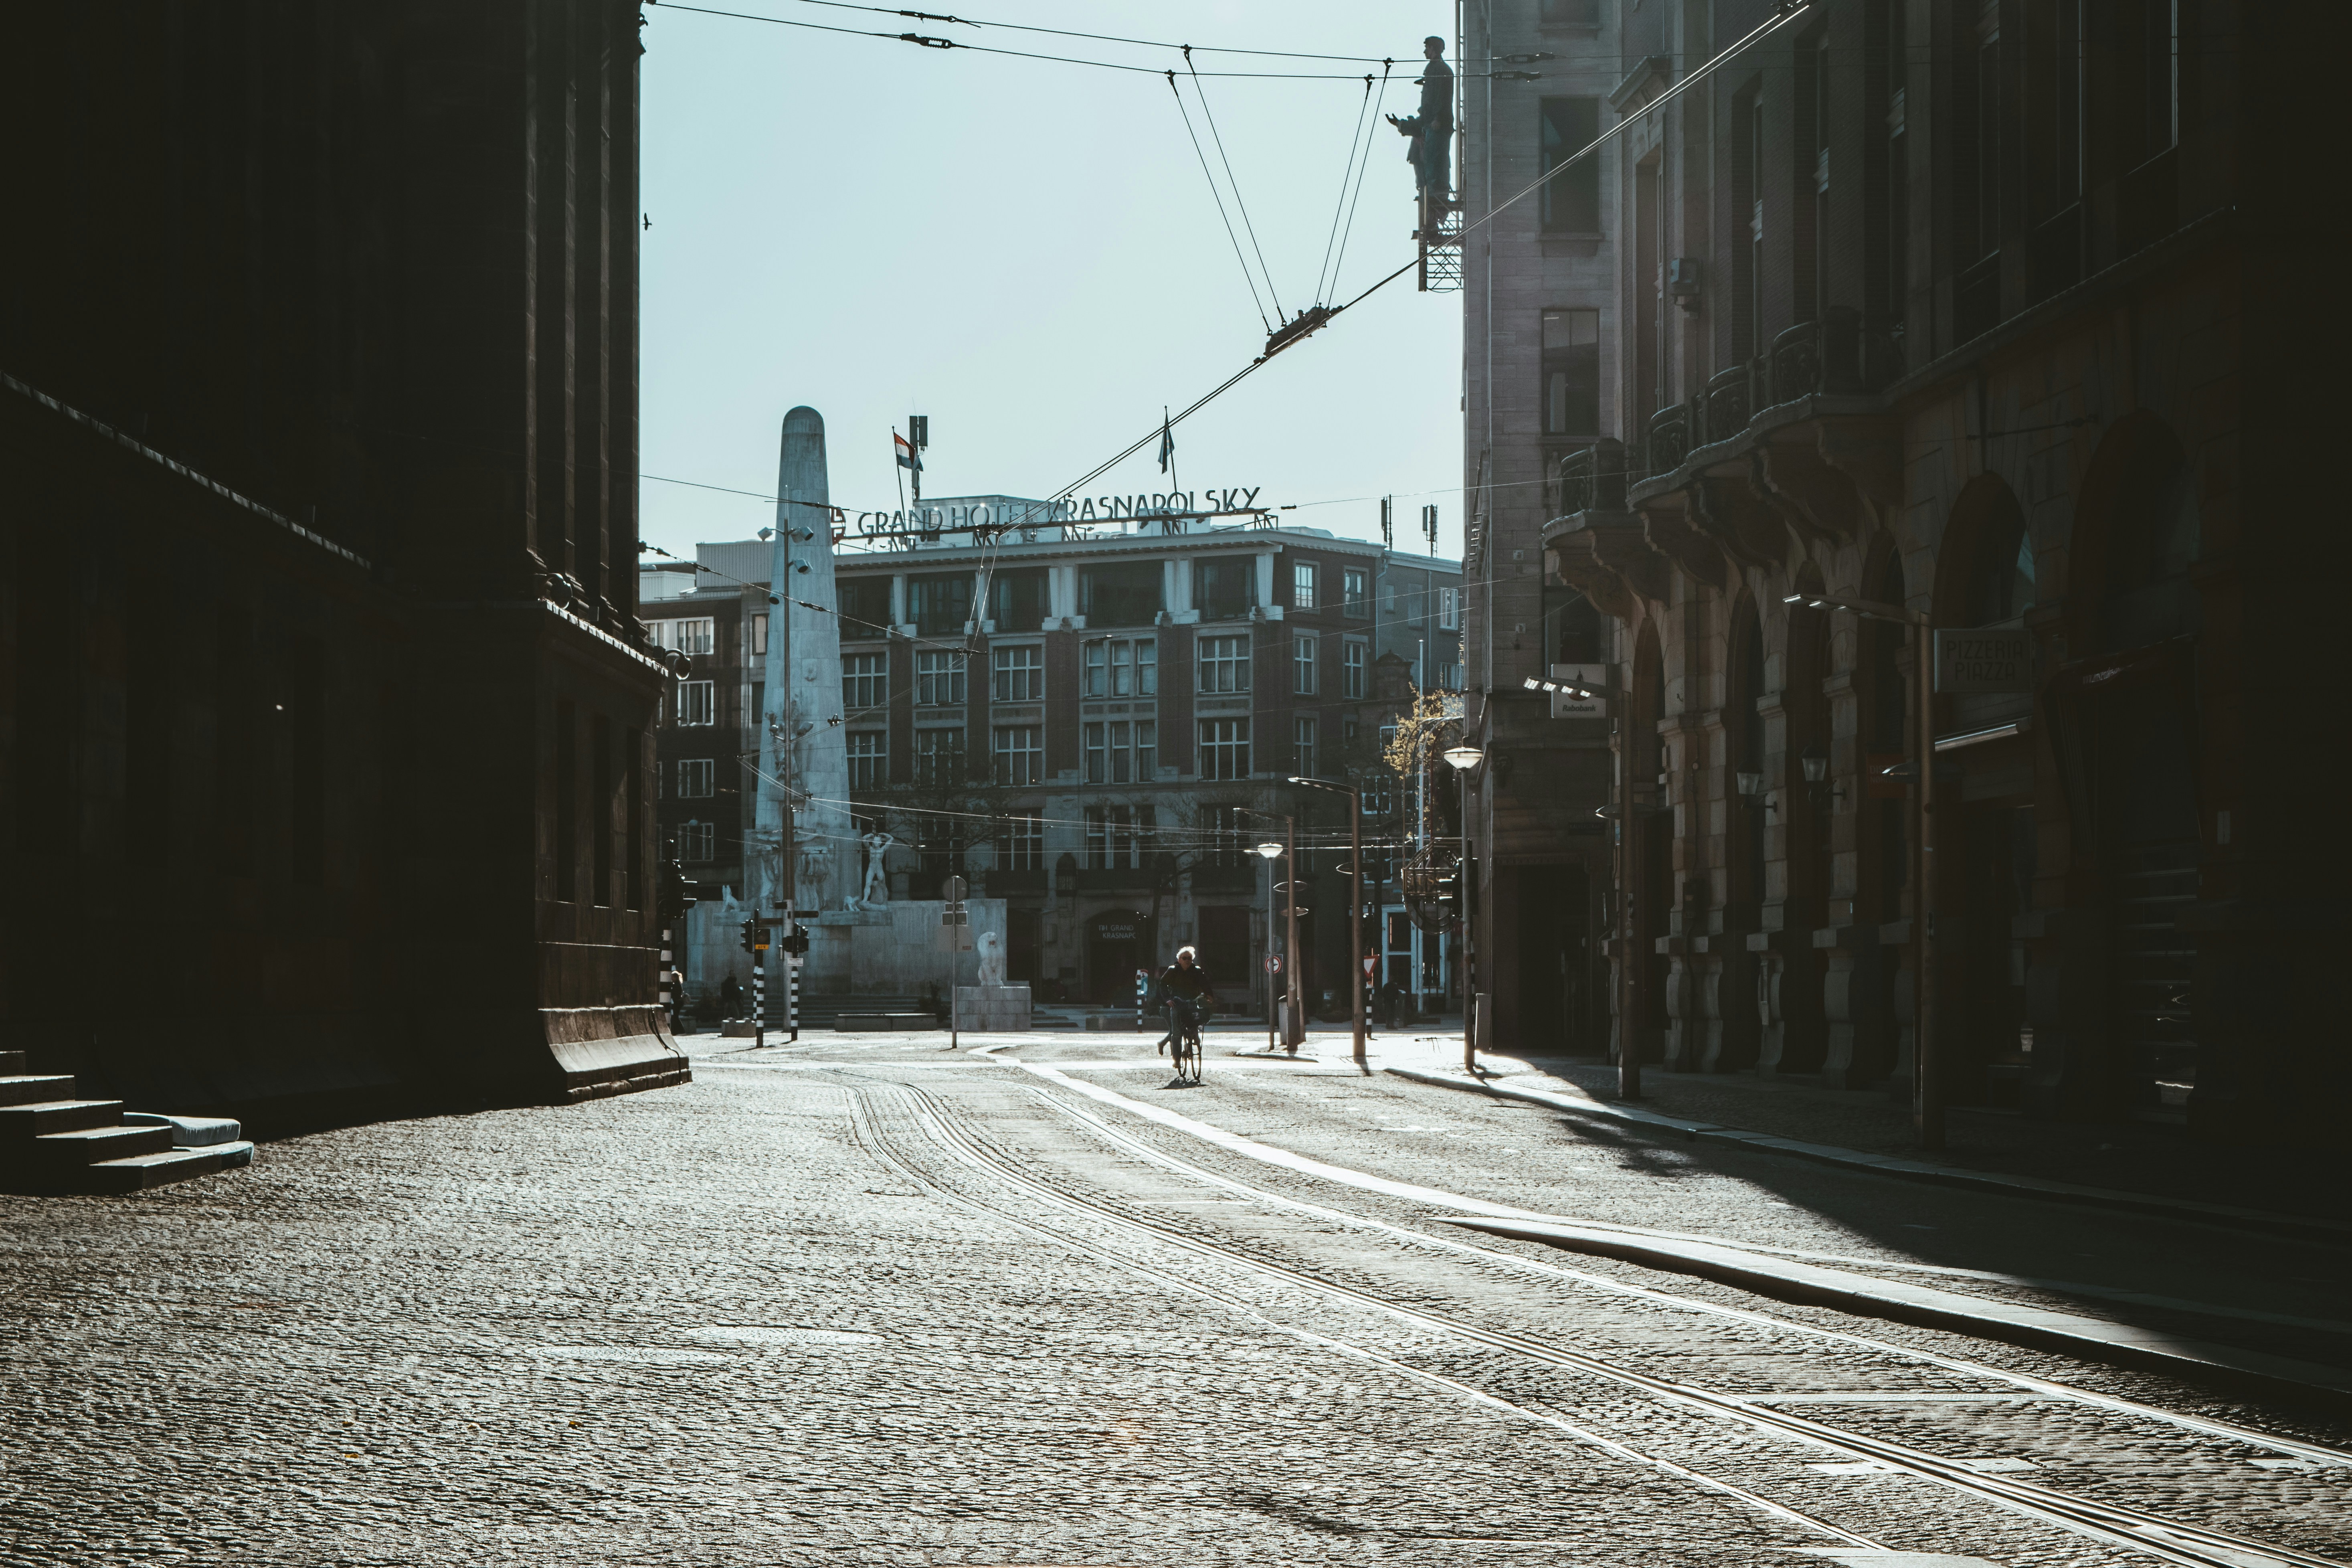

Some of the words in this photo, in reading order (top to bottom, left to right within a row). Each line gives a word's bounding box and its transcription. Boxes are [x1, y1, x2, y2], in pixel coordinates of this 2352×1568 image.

[857, 508, 943, 534] GRAND
[951, 502, 1033, 528] HOTEL
[1047, 487, 1260, 522] KRASNAPOLSKY
[1946, 640, 2023, 660] PIZZERIA
[1954, 662, 2015, 681] PIAZZA
